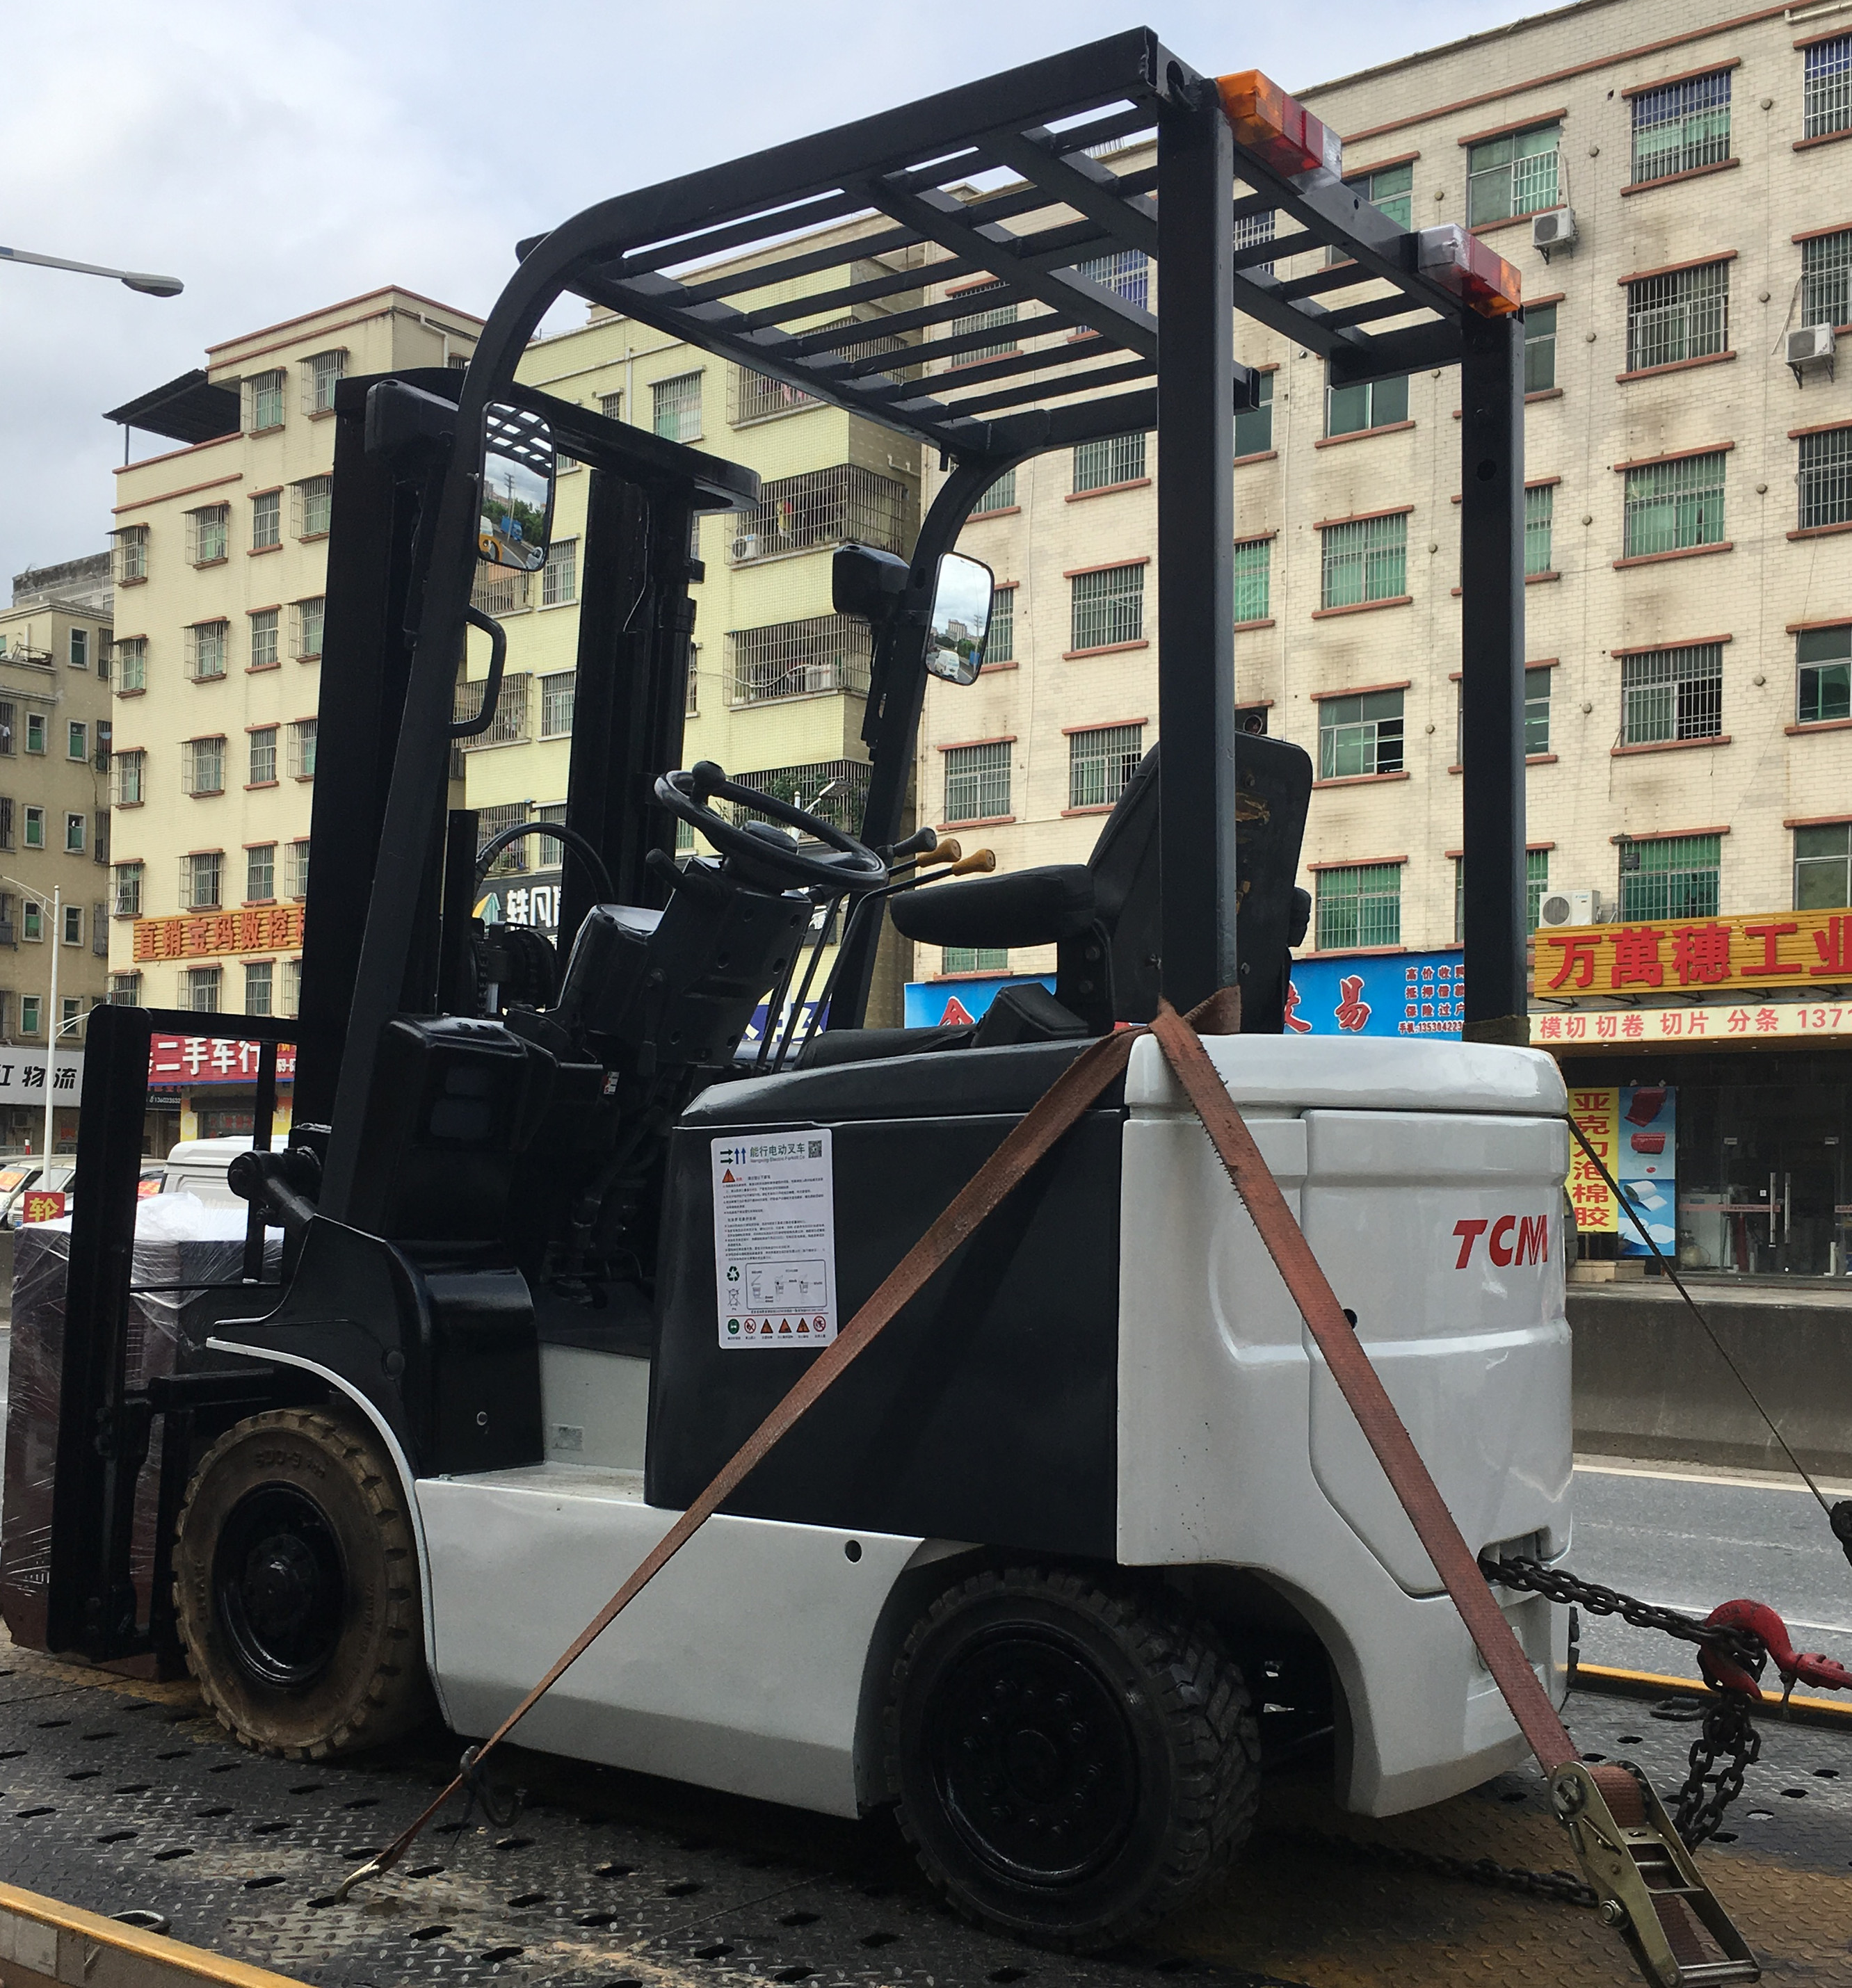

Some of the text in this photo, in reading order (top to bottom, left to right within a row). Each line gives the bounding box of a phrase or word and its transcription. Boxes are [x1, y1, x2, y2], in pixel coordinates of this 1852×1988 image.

[1405, 1001, 1465, 1018] 保险过户
[1660, 1011, 1709, 1035] 切片
[1728, 1007, 1779, 1033] 分条
[149, 1037, 261, 1076] 二手车行
[750, 1142, 806, 1158] 能行电动叉车
[1572, 1092, 1611, 1228] 亚克力泡棉胶
[29, 1197, 60, 1222] 轮
[1452, 1214, 1548, 1270] TCM
